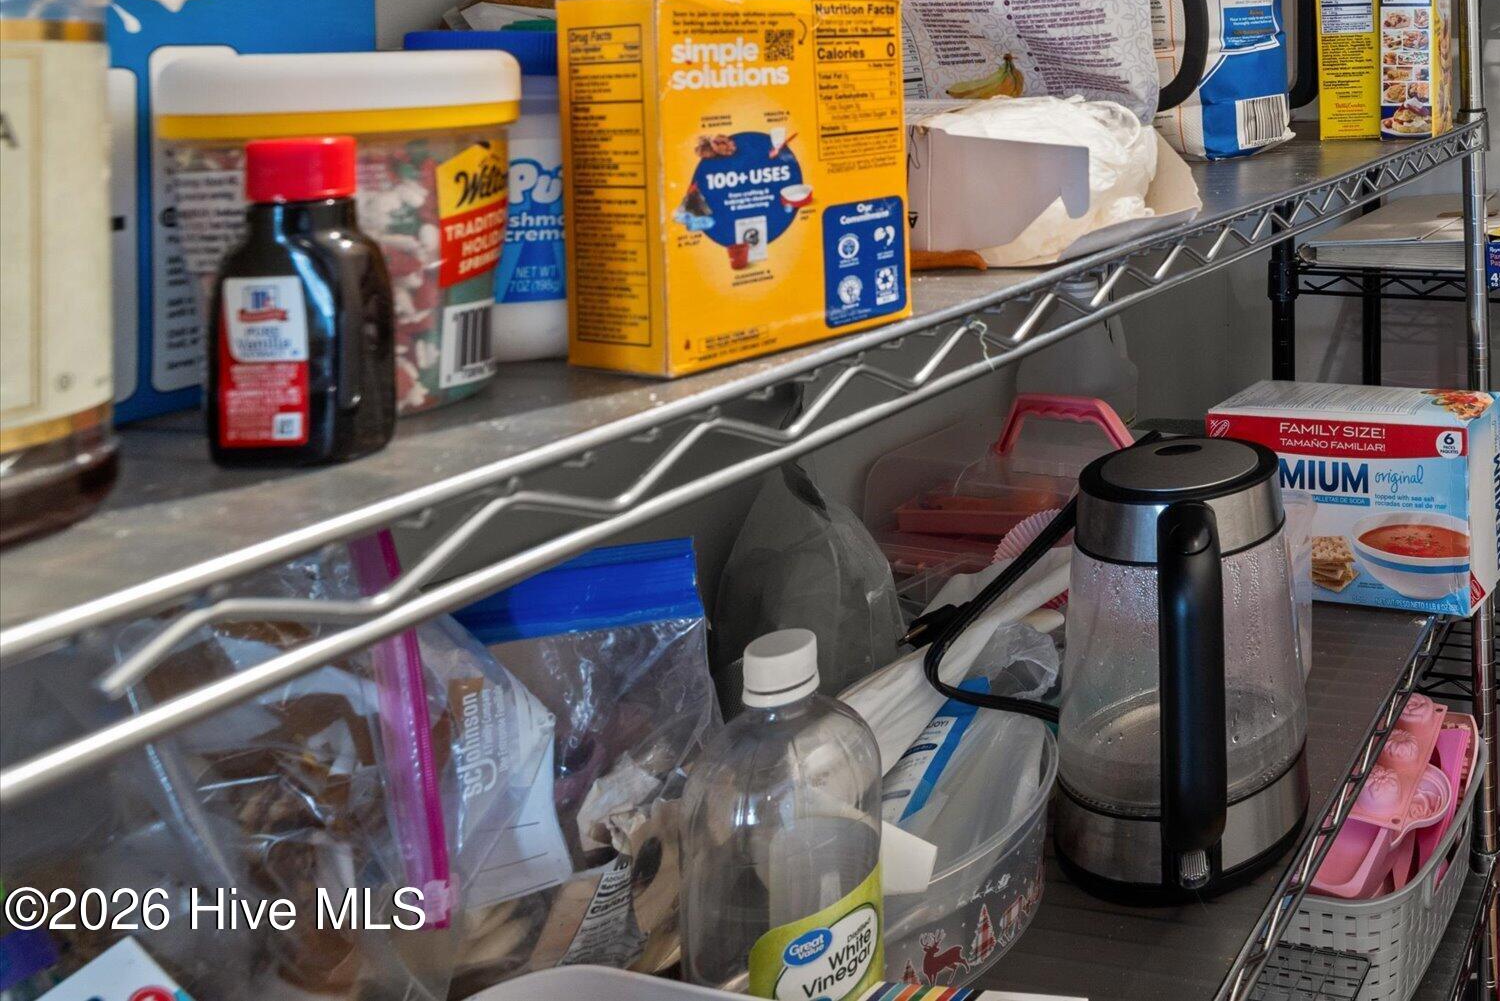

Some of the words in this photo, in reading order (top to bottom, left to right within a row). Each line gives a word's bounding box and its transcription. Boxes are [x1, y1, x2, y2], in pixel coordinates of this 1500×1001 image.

[815, 3, 864, 15] Nutrition
[867, 3, 895, 15] Facts
[570, 32, 588, 44] Drug
[591, 30, 612, 41] Facts
[672, 36, 759, 64] simple
[817, 46, 865, 60] Calories
[886, 42, 895, 57] 0
[672, 62, 790, 90] solutions
[508, 162, 562, 205] Pu
[706, 171, 748, 190] 100+
[750, 165, 791, 184] USES
[857, 203, 873, 213] Our
[516, 266, 540, 279] NET
[541, 264, 557, 277] WT
[1280, 422, 1339, 437] FAMILY
[1343, 426, 1386, 439] SIZE!
[1443, 433, 1454, 445] 6
[1280, 437, 1327, 448] TAMAÑO
[1331, 440, 1386, 452] FAMILIAR!
[1279, 458, 1369, 494] MIUM
[1375, 465, 1424, 492] original
[1349, 498, 1367, 506] SODA
[1375, 494, 1397, 502] topped
[1375, 500, 1401, 508] rociadas
[789, 934, 824, 956] Great
[798, 943, 824, 961] Value
[828, 929, 871, 970] White
[802, 942, 872, 998] Vinegar
